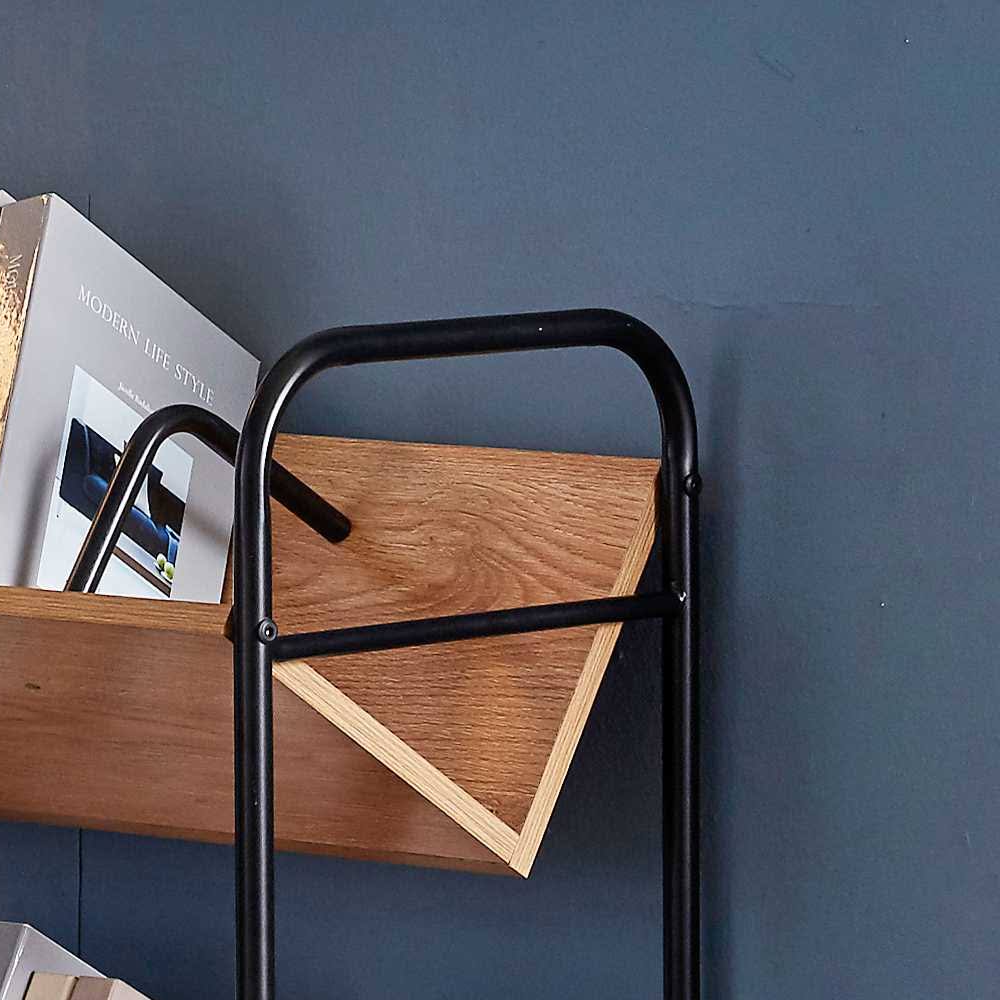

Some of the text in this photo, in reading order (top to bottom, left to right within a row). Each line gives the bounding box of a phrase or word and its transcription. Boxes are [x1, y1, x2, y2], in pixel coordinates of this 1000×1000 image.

[78, 284, 140, 344] MODERN
[143, 338, 170, 371] LIFE
[174, 363, 215, 406] STYLE
